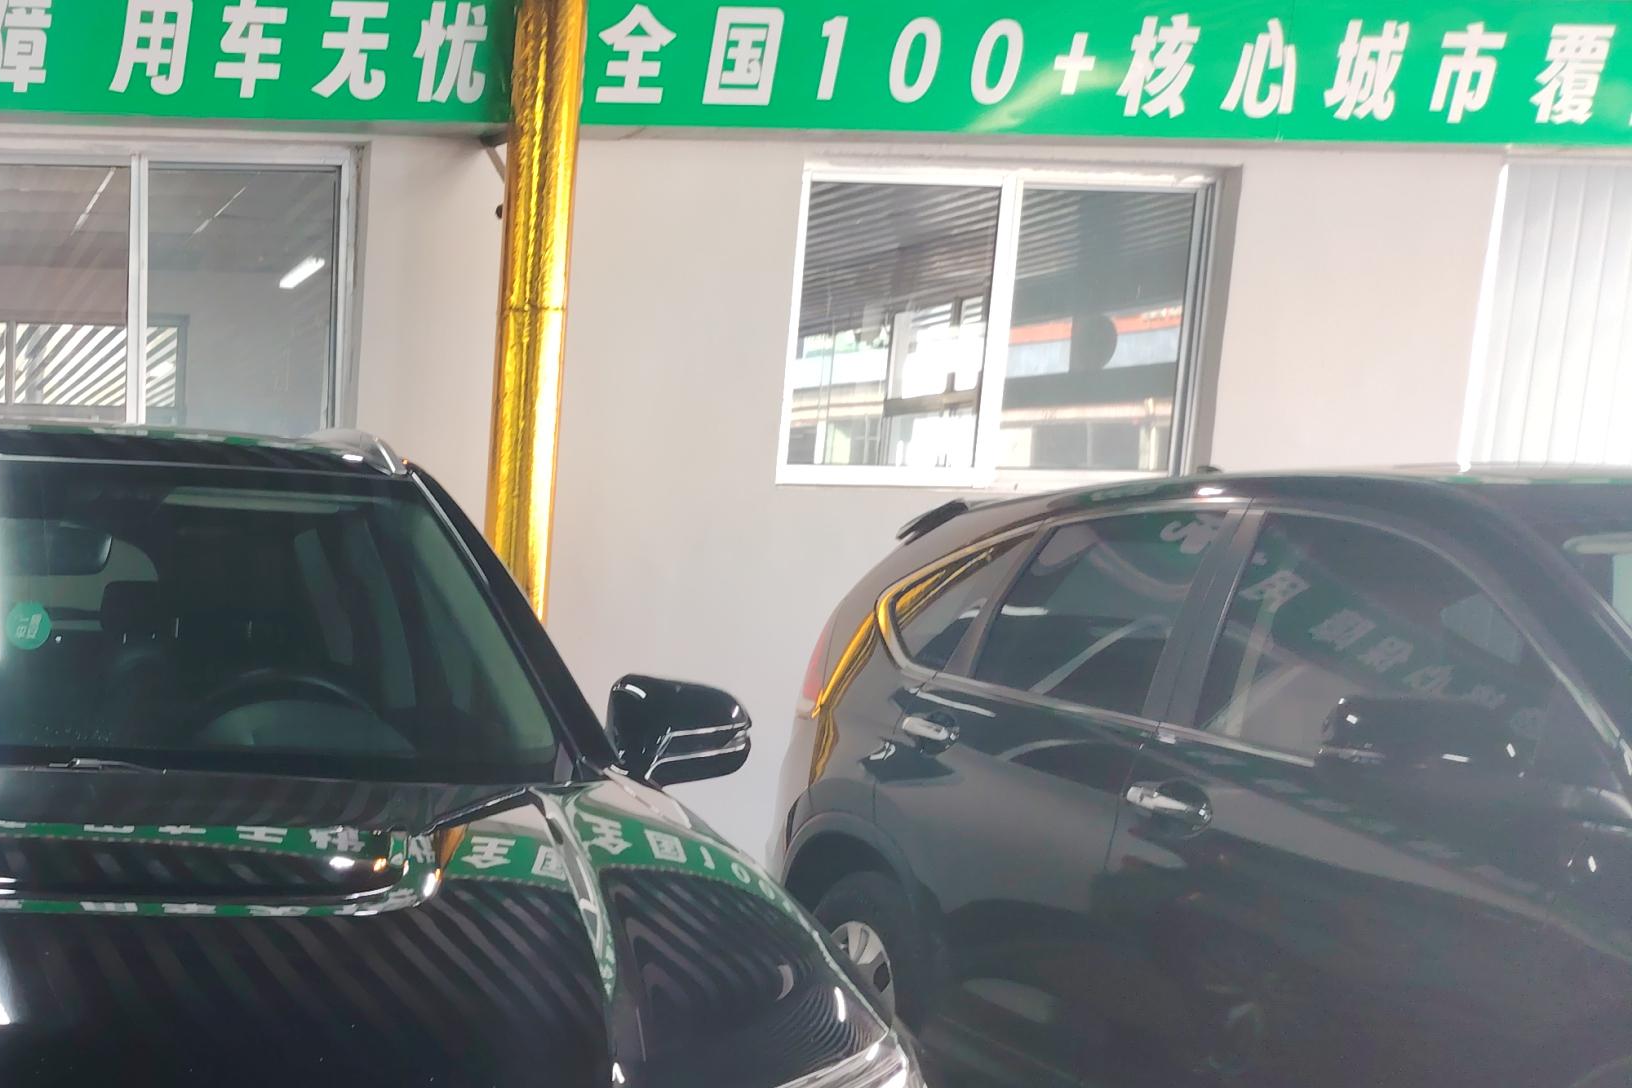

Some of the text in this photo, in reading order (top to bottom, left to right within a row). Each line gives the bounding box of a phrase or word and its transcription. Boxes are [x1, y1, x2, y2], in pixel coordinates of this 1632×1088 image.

[108, 4, 487, 104] 用车无忧
[594, 4, 1632, 125] 全国100+核心城市覆
